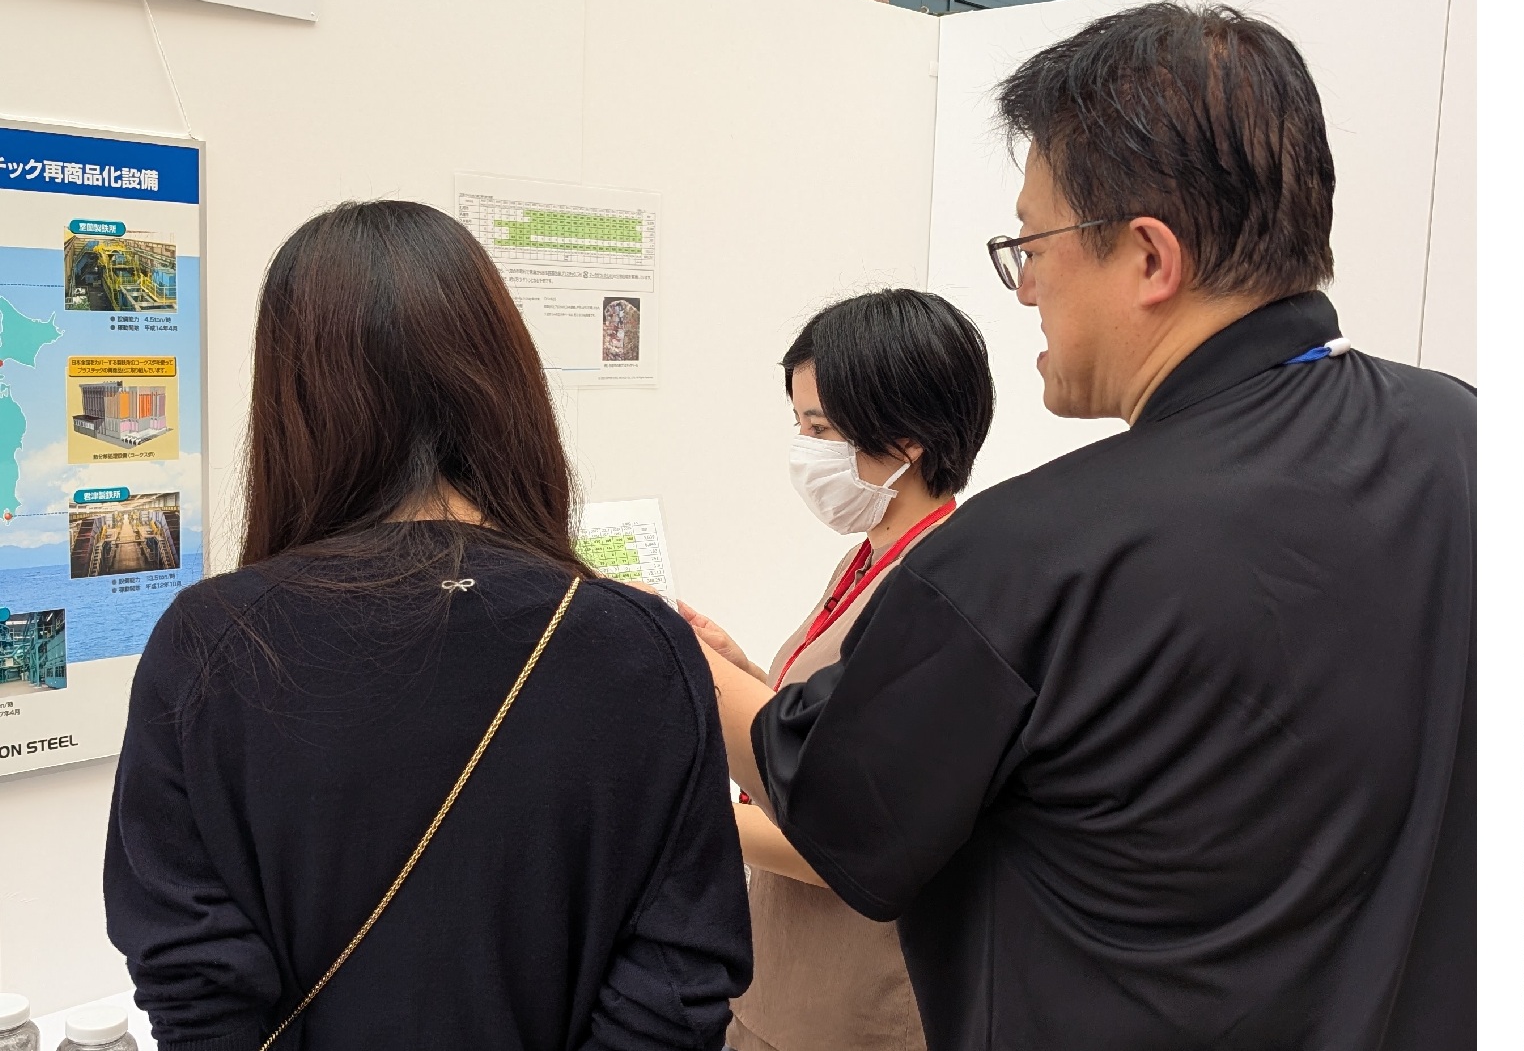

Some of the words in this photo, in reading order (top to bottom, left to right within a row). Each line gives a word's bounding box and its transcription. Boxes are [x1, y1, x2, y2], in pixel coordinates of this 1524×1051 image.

[83, 490, 121, 501] 君津製鉄所
[0, 743, 22, 759] ON
[26, 734, 79, 754] STEEL
